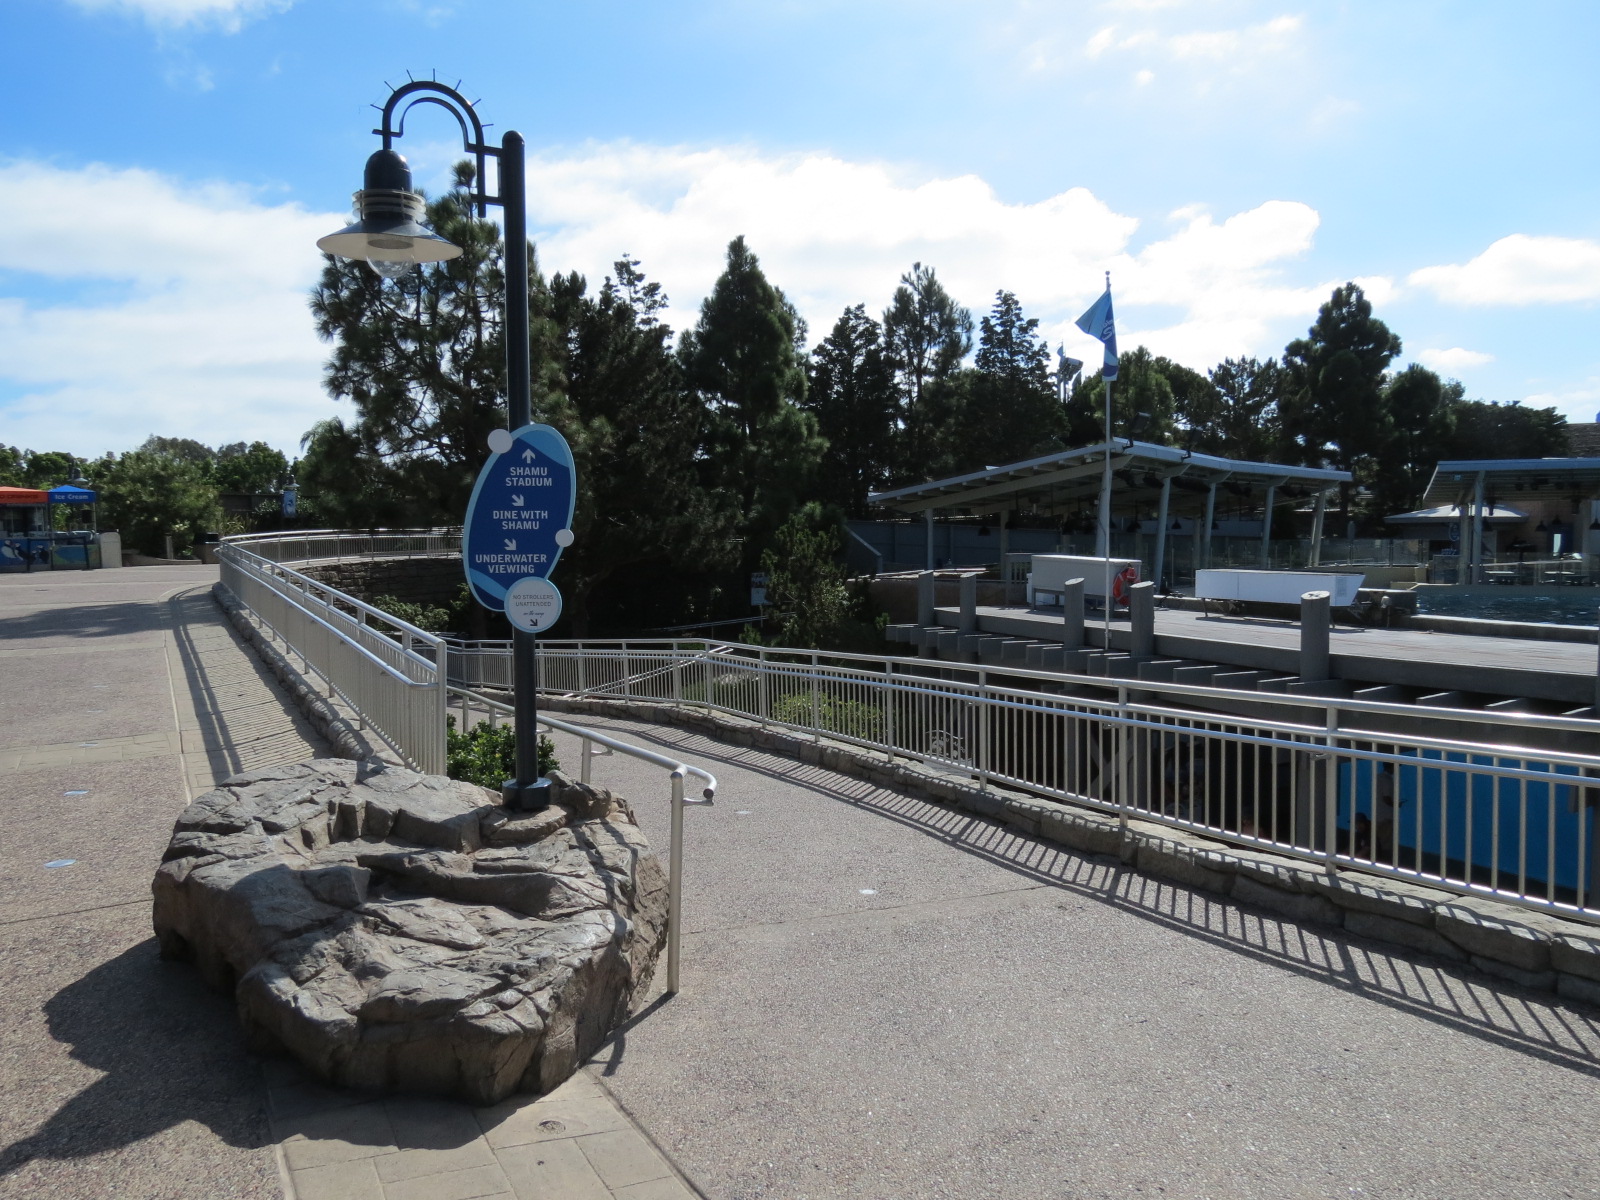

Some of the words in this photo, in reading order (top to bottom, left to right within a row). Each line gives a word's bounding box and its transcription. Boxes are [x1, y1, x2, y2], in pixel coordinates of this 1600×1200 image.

[509, 466, 548, 476] SHAMU
[505, 477, 553, 487] STADIUM
[492, 510, 519, 520] DINE
[520, 510, 548, 520] WITH
[501, 520, 540, 530] SHAMU
[475, 553, 547, 563] UNDERWATER
[487, 564, 535, 574] VIEWING
